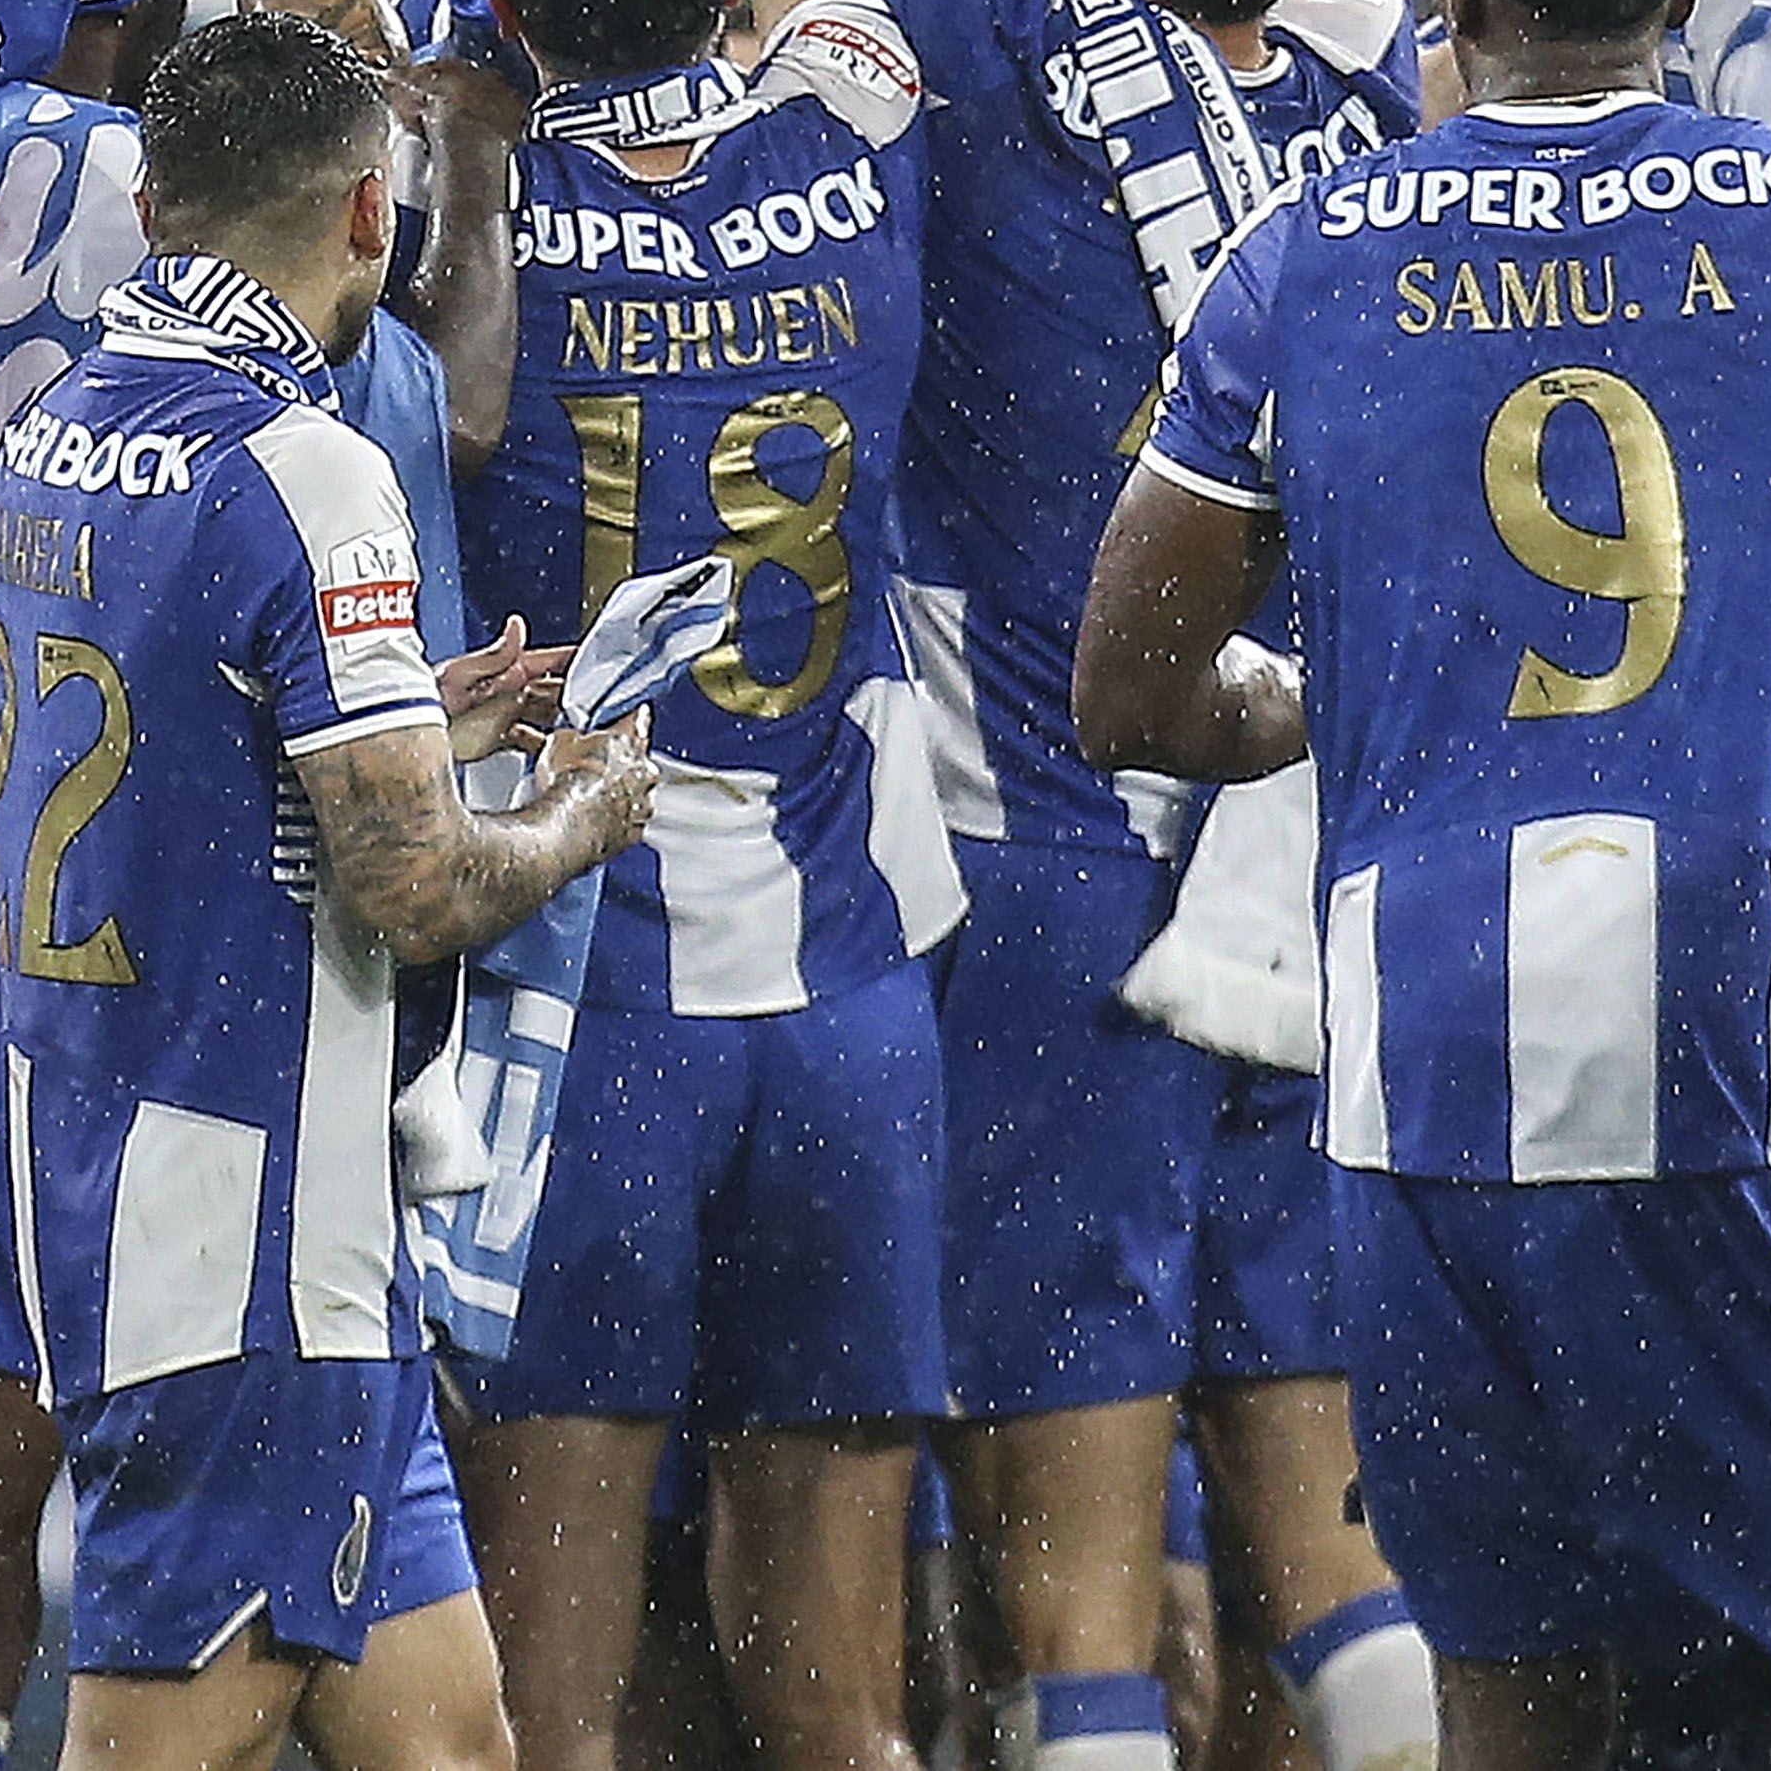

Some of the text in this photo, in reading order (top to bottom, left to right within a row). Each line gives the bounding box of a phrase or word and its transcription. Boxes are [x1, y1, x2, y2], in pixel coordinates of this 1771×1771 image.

[709, 155, 890, 273] BOCK
[1317, 162, 1565, 239] SUPER
[560, 276, 861, 376] NEHUEN
[1394, 241, 1735, 337] SAMU. A
[43, 422, 214, 496] BOCK
[555, 388, 855, 720] 18
[1482, 363, 1688, 722] 9
